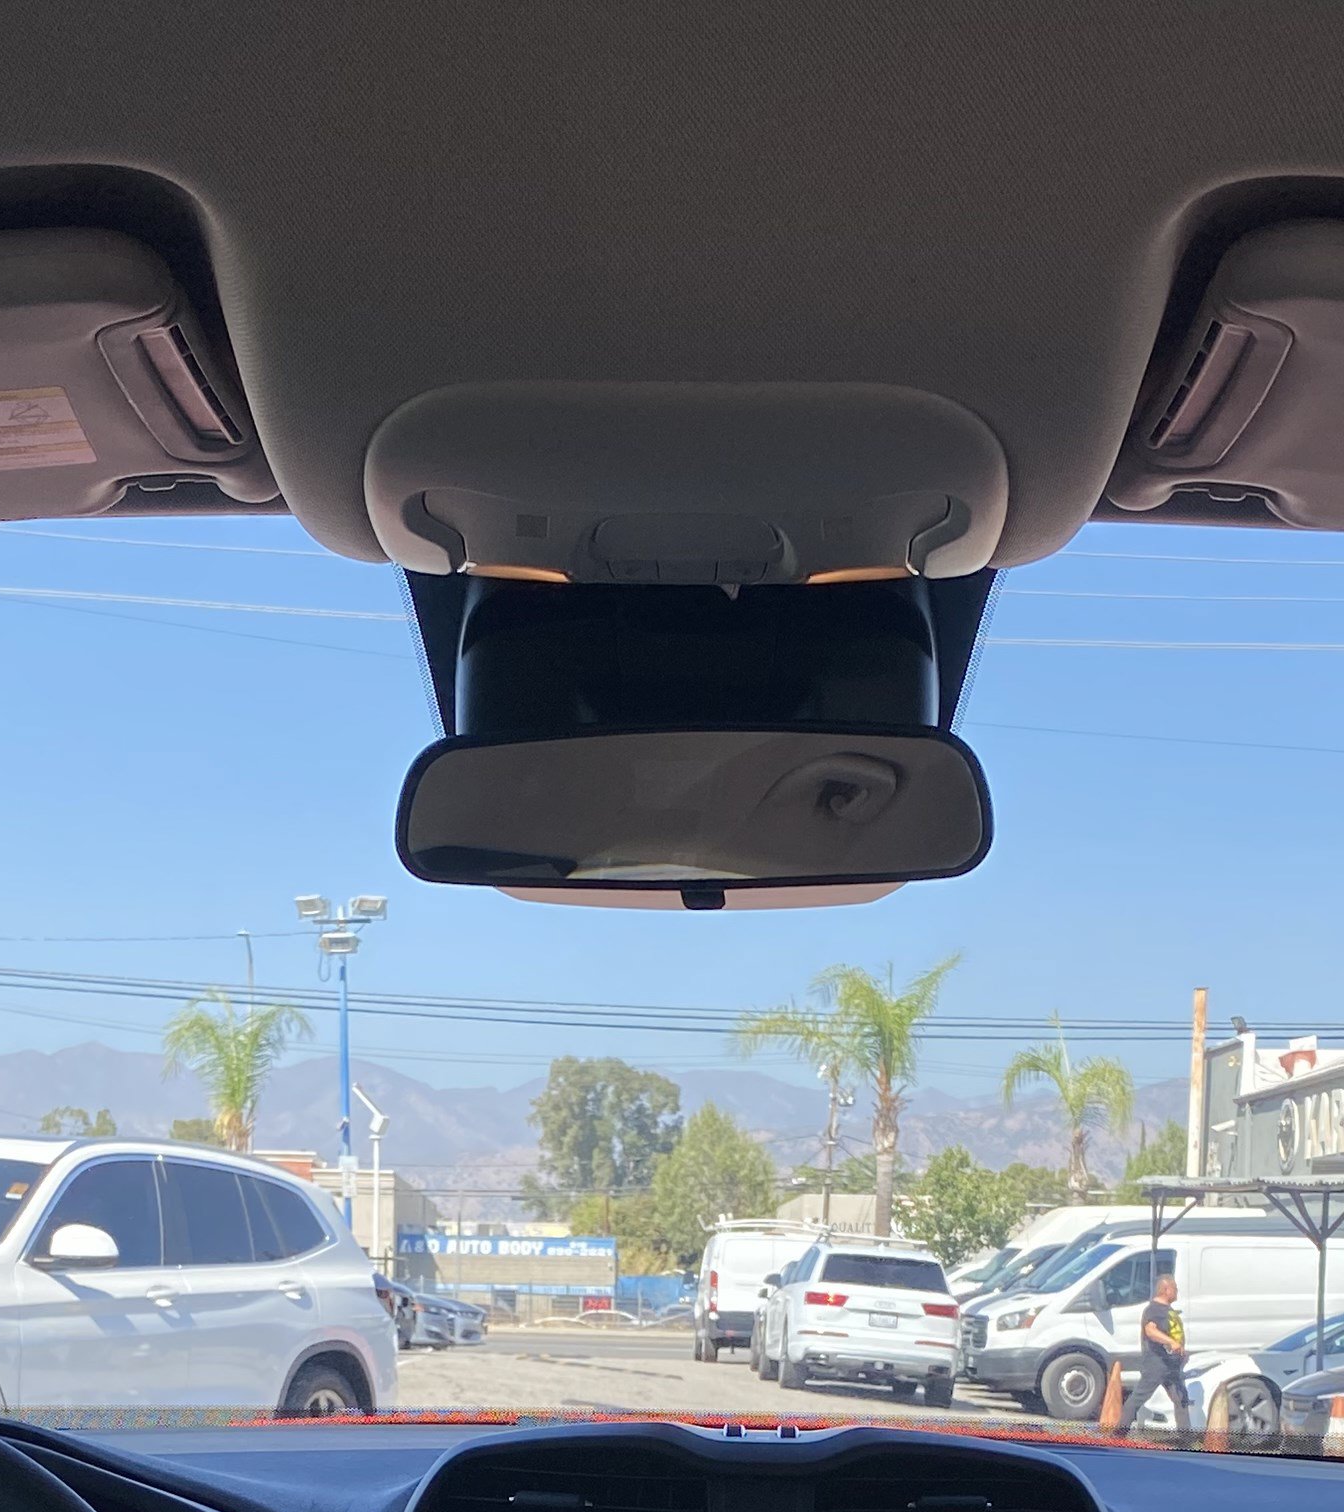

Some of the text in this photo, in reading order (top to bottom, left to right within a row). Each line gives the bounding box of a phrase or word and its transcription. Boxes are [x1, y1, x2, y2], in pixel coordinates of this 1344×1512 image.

[831, 1222, 872, 1233] QUALIT
[446, 1239, 493, 1255] AUTO
[498, 1240, 545, 1256] BODY
